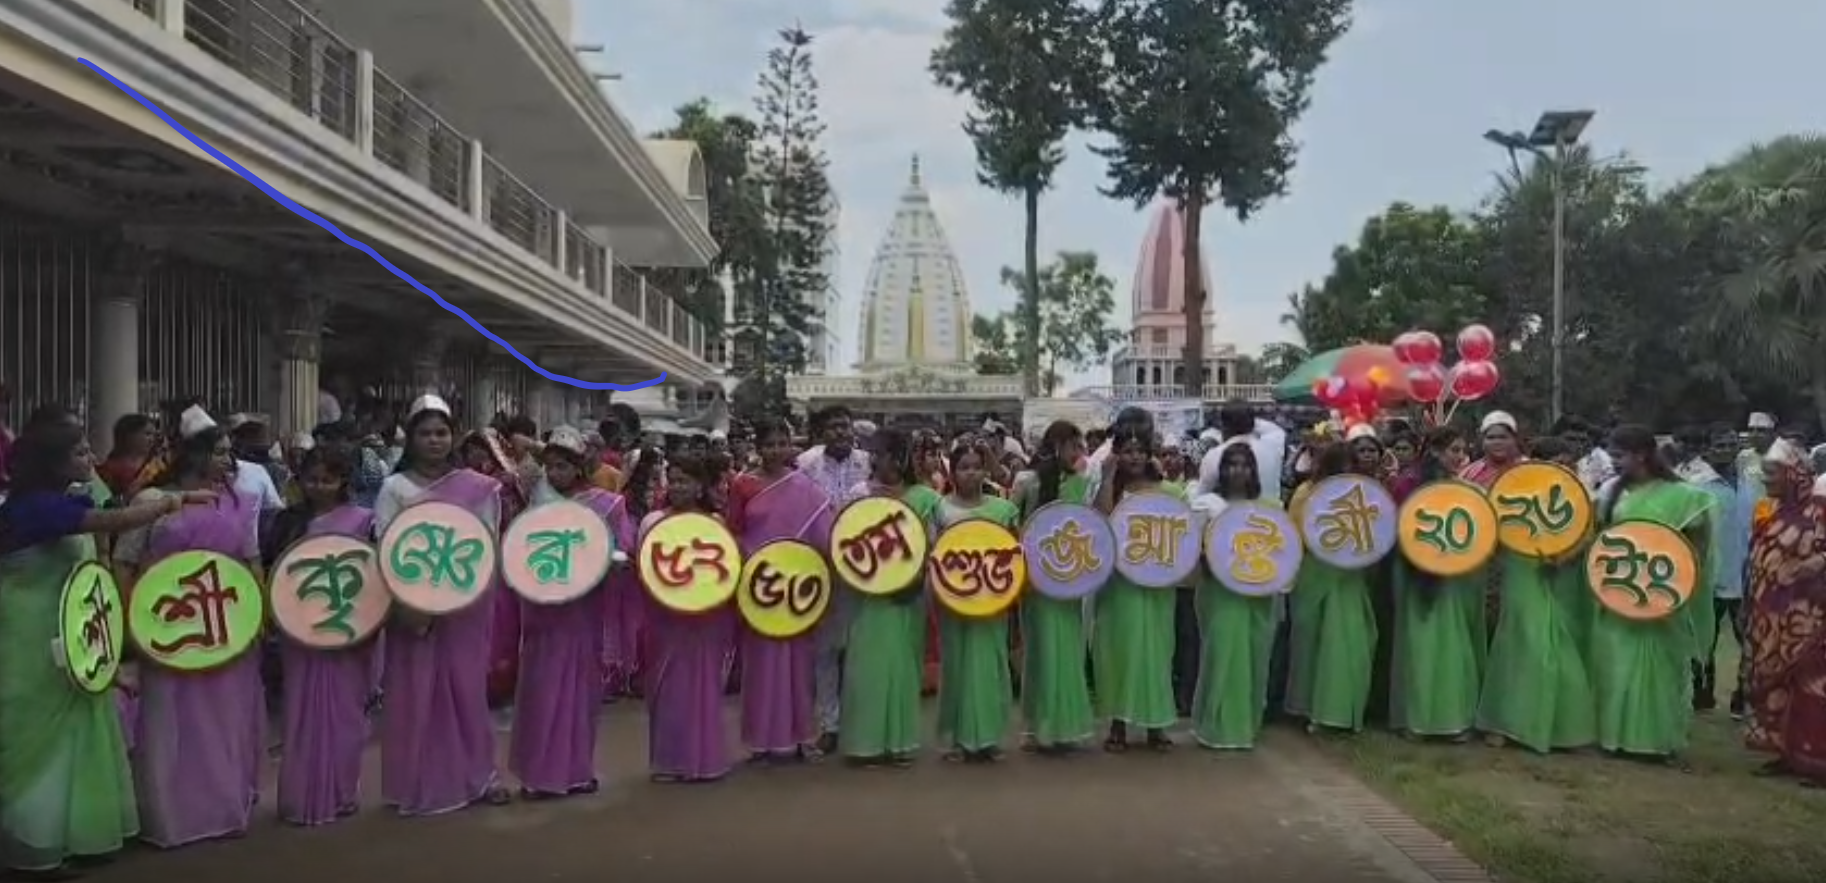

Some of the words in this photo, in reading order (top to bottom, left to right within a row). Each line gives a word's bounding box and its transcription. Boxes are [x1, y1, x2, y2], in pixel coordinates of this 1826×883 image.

[1124, 512, 1188, 568] ন্মা
[1316, 482, 1381, 555] মী
[1414, 498, 1476, 554] ২০
[1497, 483, 1575, 538] ২৬
[526, 528, 586, 584] র
[651, 537, 730, 588] ৫২
[838, 510, 912, 580] তম
[928, 545, 1025, 597] শুভ
[1038, 519, 1101, 581] জ
[1594, 532, 1682, 608] ইং
[150, 560, 238, 653] শ্রী
[287, 549, 371, 640] কৃ
